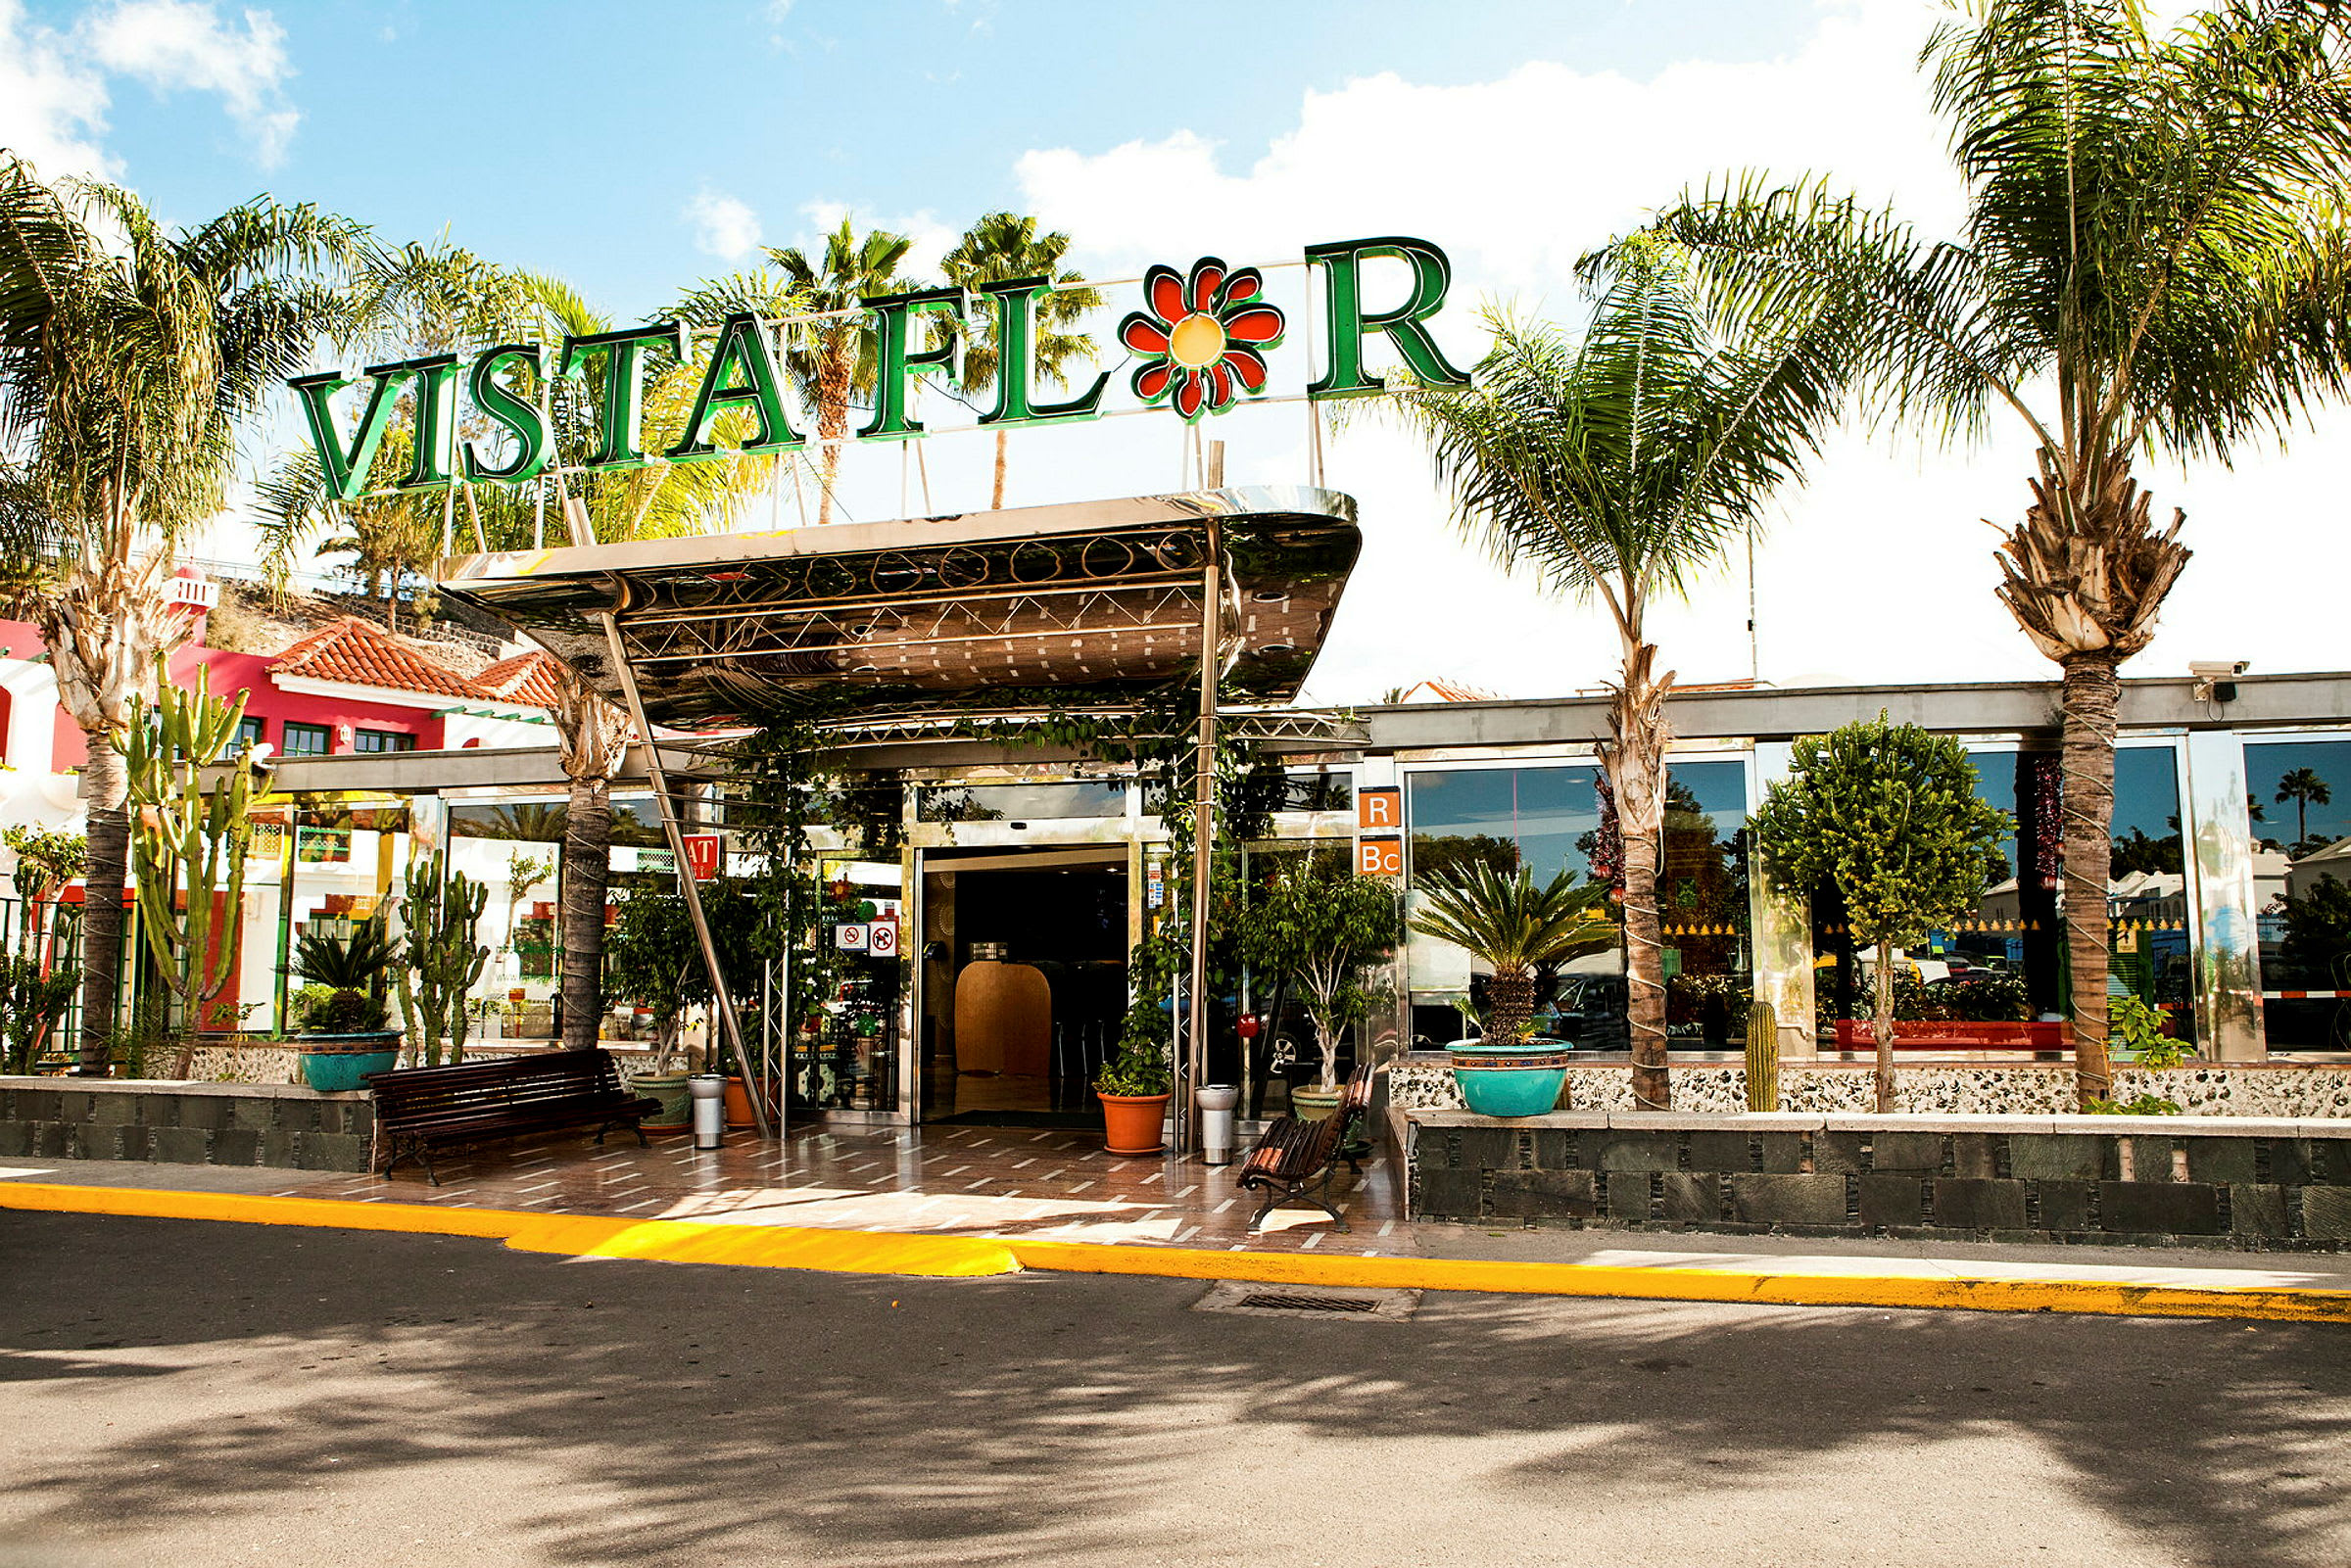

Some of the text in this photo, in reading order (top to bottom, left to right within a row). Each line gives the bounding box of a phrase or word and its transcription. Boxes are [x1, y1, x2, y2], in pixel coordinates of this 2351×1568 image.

[1369, 797, 1388, 823] R
[689, 840, 713, 863] AT
[1363, 846, 1398, 871] Bc
